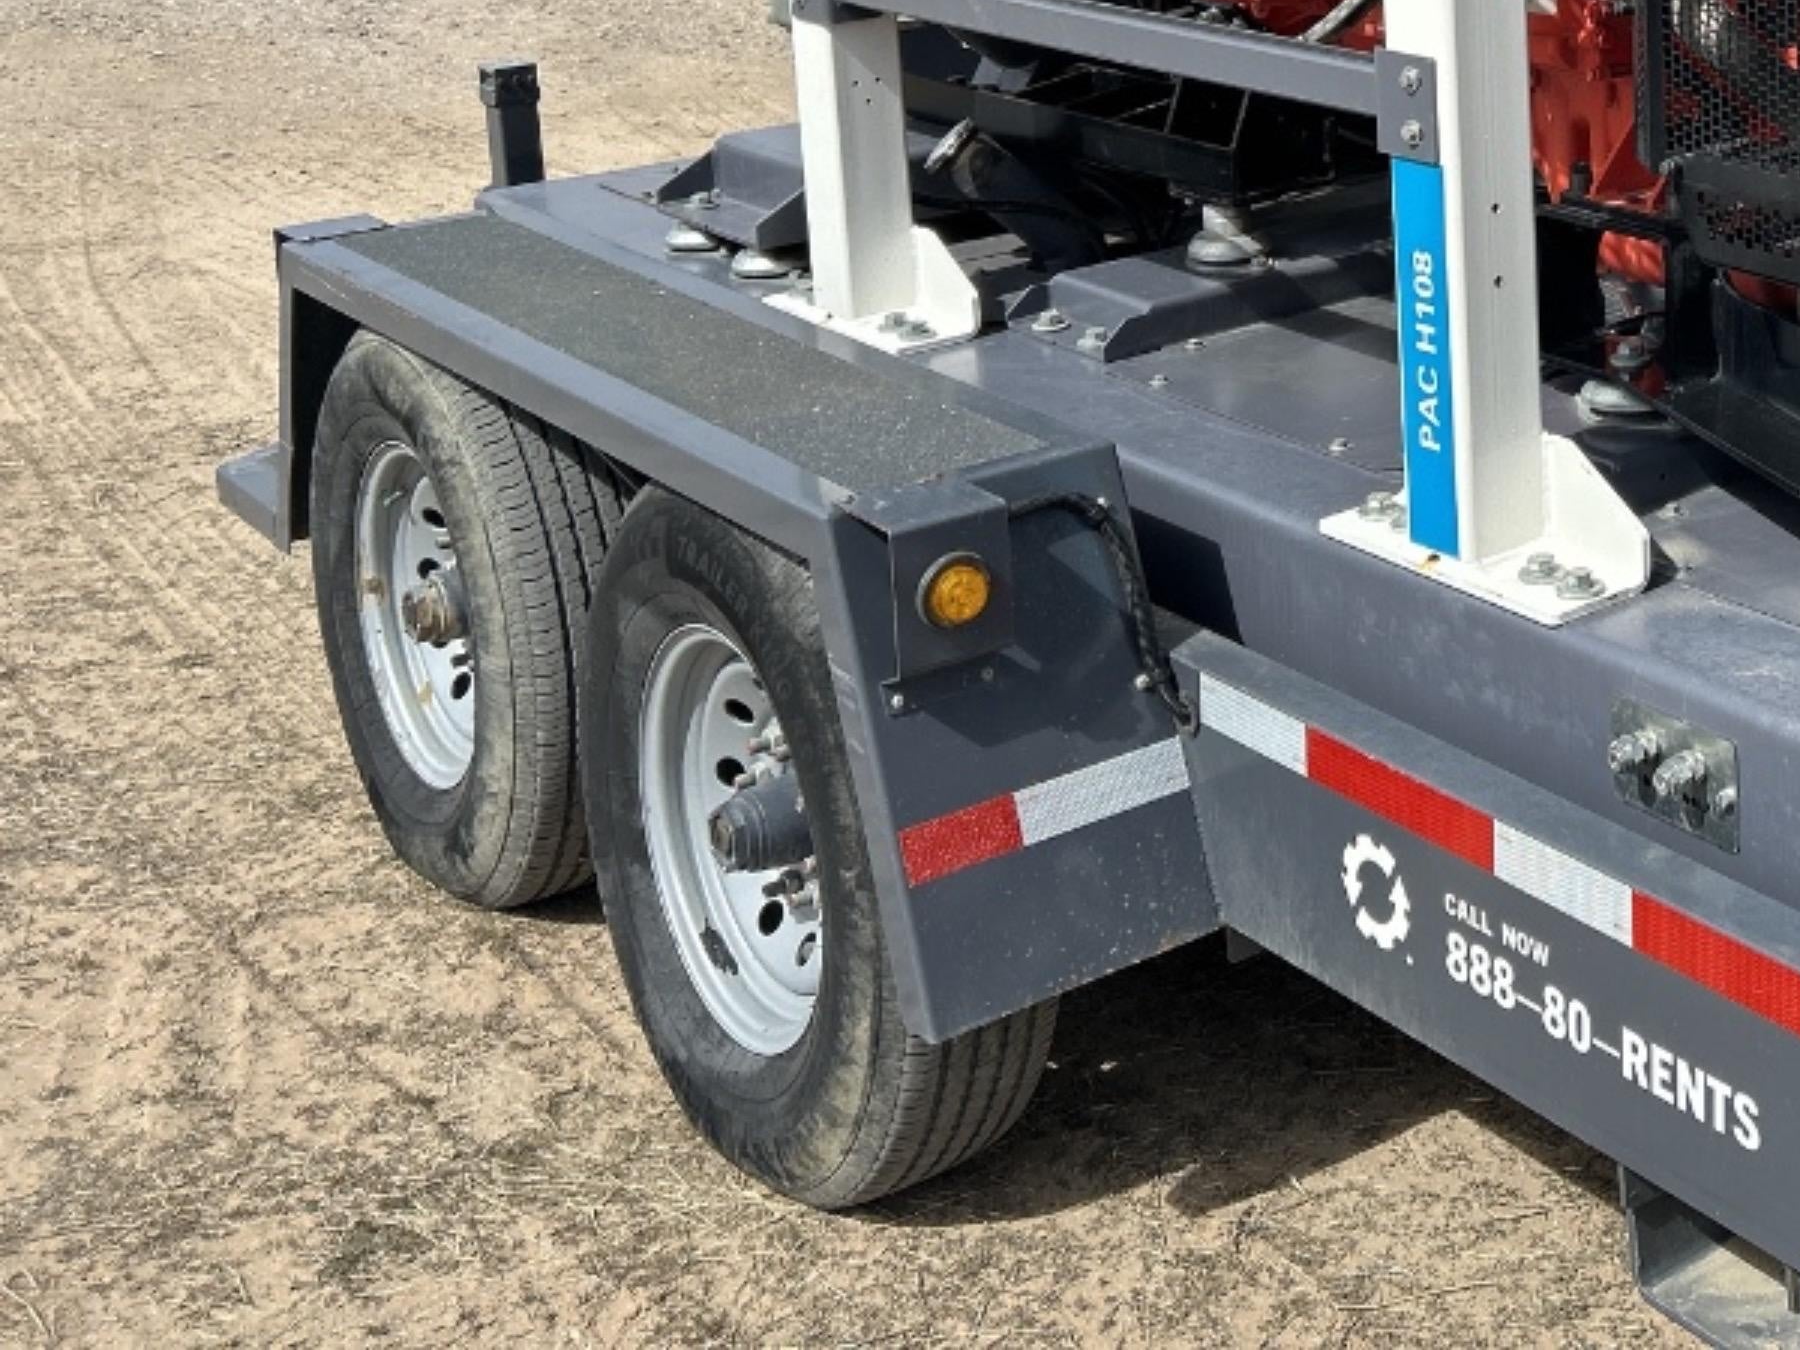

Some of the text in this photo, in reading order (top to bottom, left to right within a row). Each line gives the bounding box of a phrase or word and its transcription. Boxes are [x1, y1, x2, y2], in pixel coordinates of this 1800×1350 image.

[1412, 250, 1441, 452] PAC H108
[1444, 893, 1549, 967] CALL NOW
[1445, 931, 1762, 1151] 888-80-RENTS
